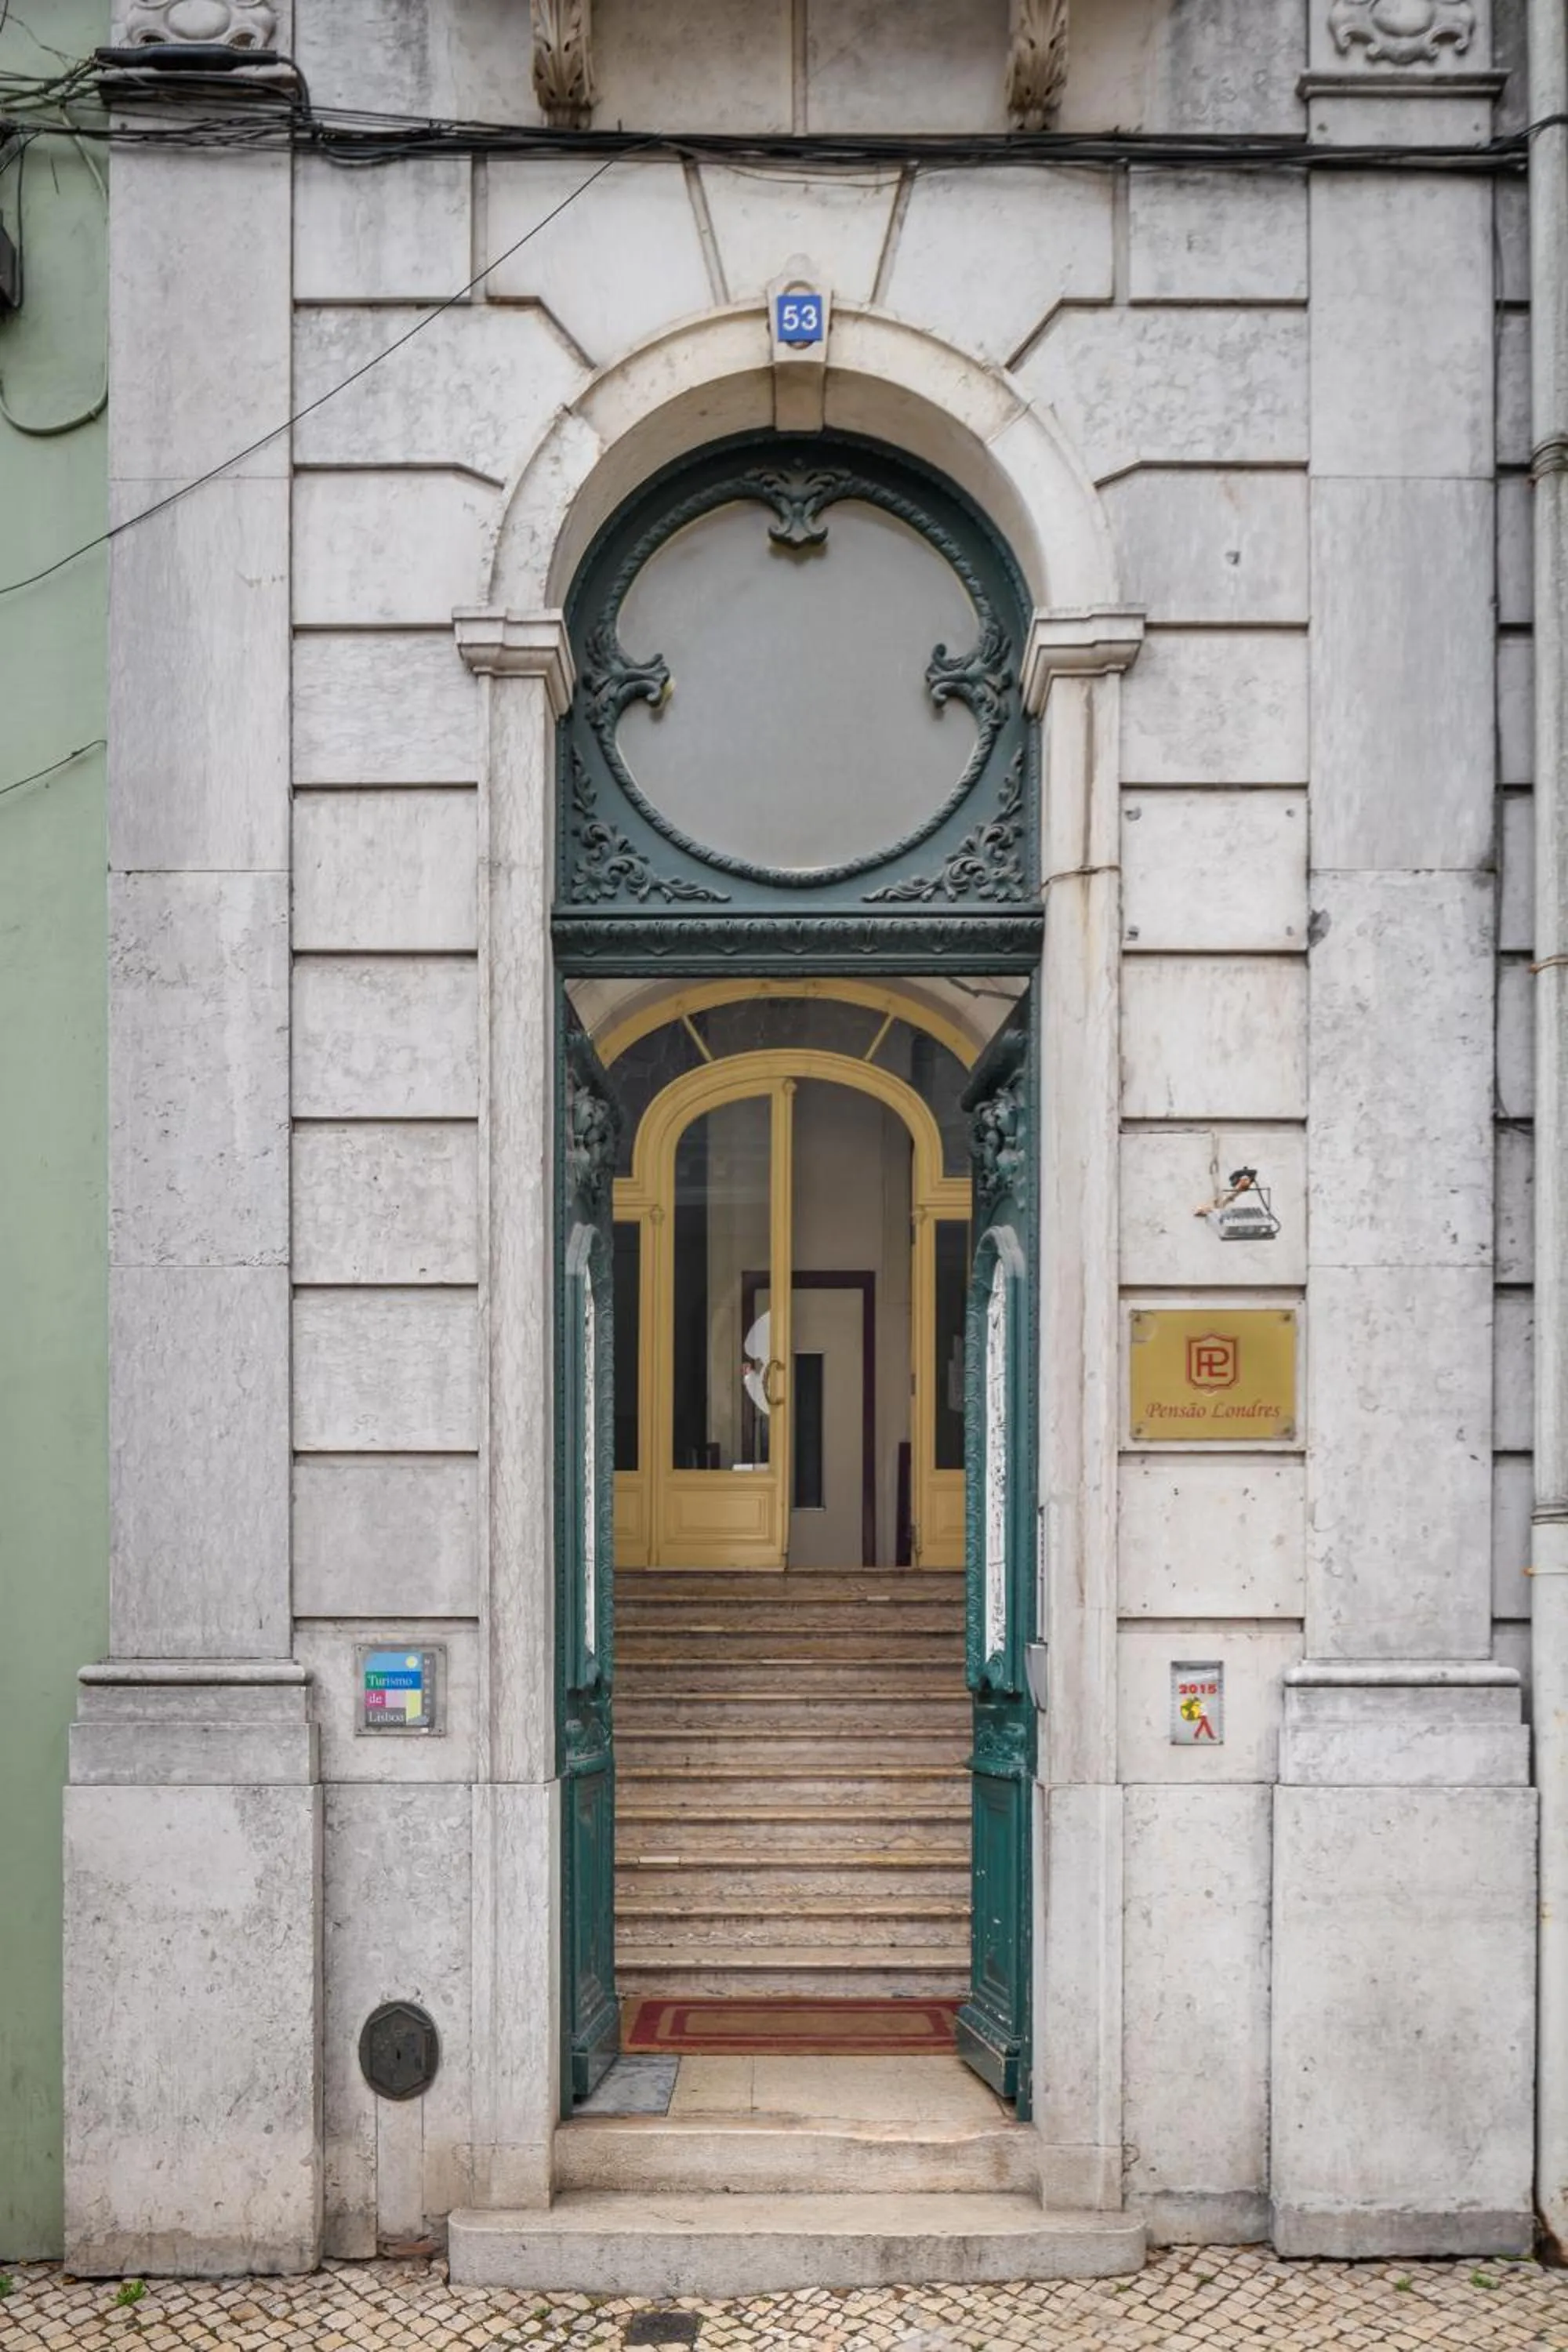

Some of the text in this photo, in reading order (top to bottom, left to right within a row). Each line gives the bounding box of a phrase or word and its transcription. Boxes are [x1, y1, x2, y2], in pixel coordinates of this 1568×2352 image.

[783, 304, 818, 331] 53
[1145, 1399, 1280, 1419] Pensão Londres
[367, 1674, 413, 1687] Turismo
[1178, 1683, 1218, 1694] 2015
[369, 1693, 383, 1704] de
[368, 1711, 405, 1722] Lisboa
